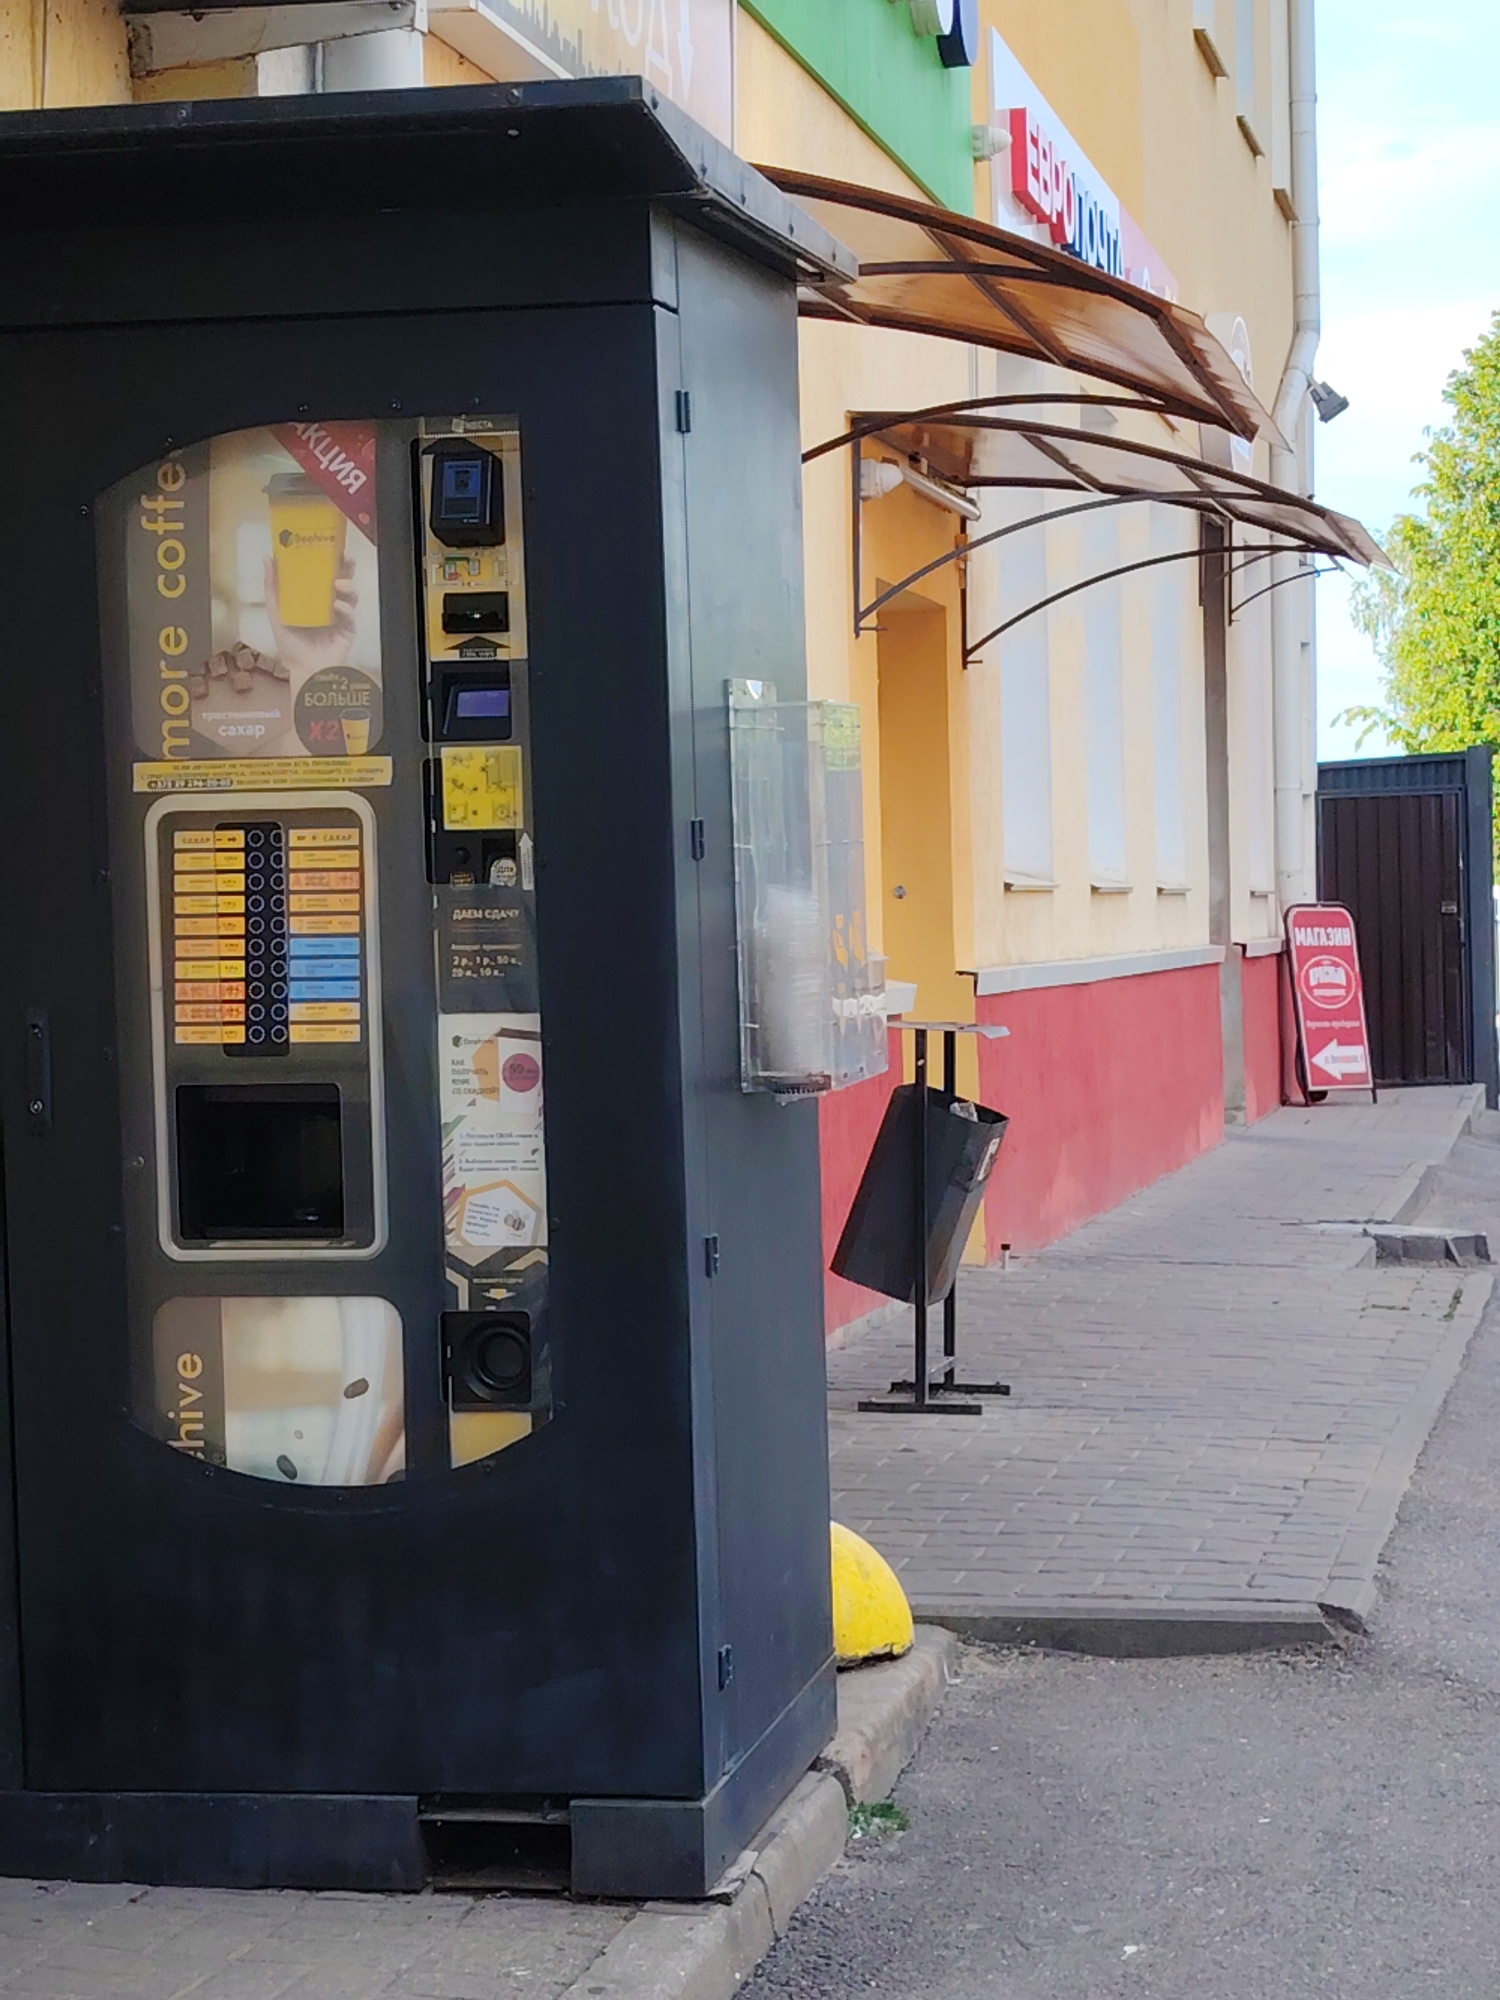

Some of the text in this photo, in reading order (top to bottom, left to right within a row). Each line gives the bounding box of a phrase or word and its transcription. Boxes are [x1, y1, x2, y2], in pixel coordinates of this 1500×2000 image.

[158, 627, 190, 761] more
[304, 691, 371, 706] БОЛЬШЕ
[217, 724, 266, 740] сахар
[452, 908, 521, 921] ДАЕМ СДАЧУ
